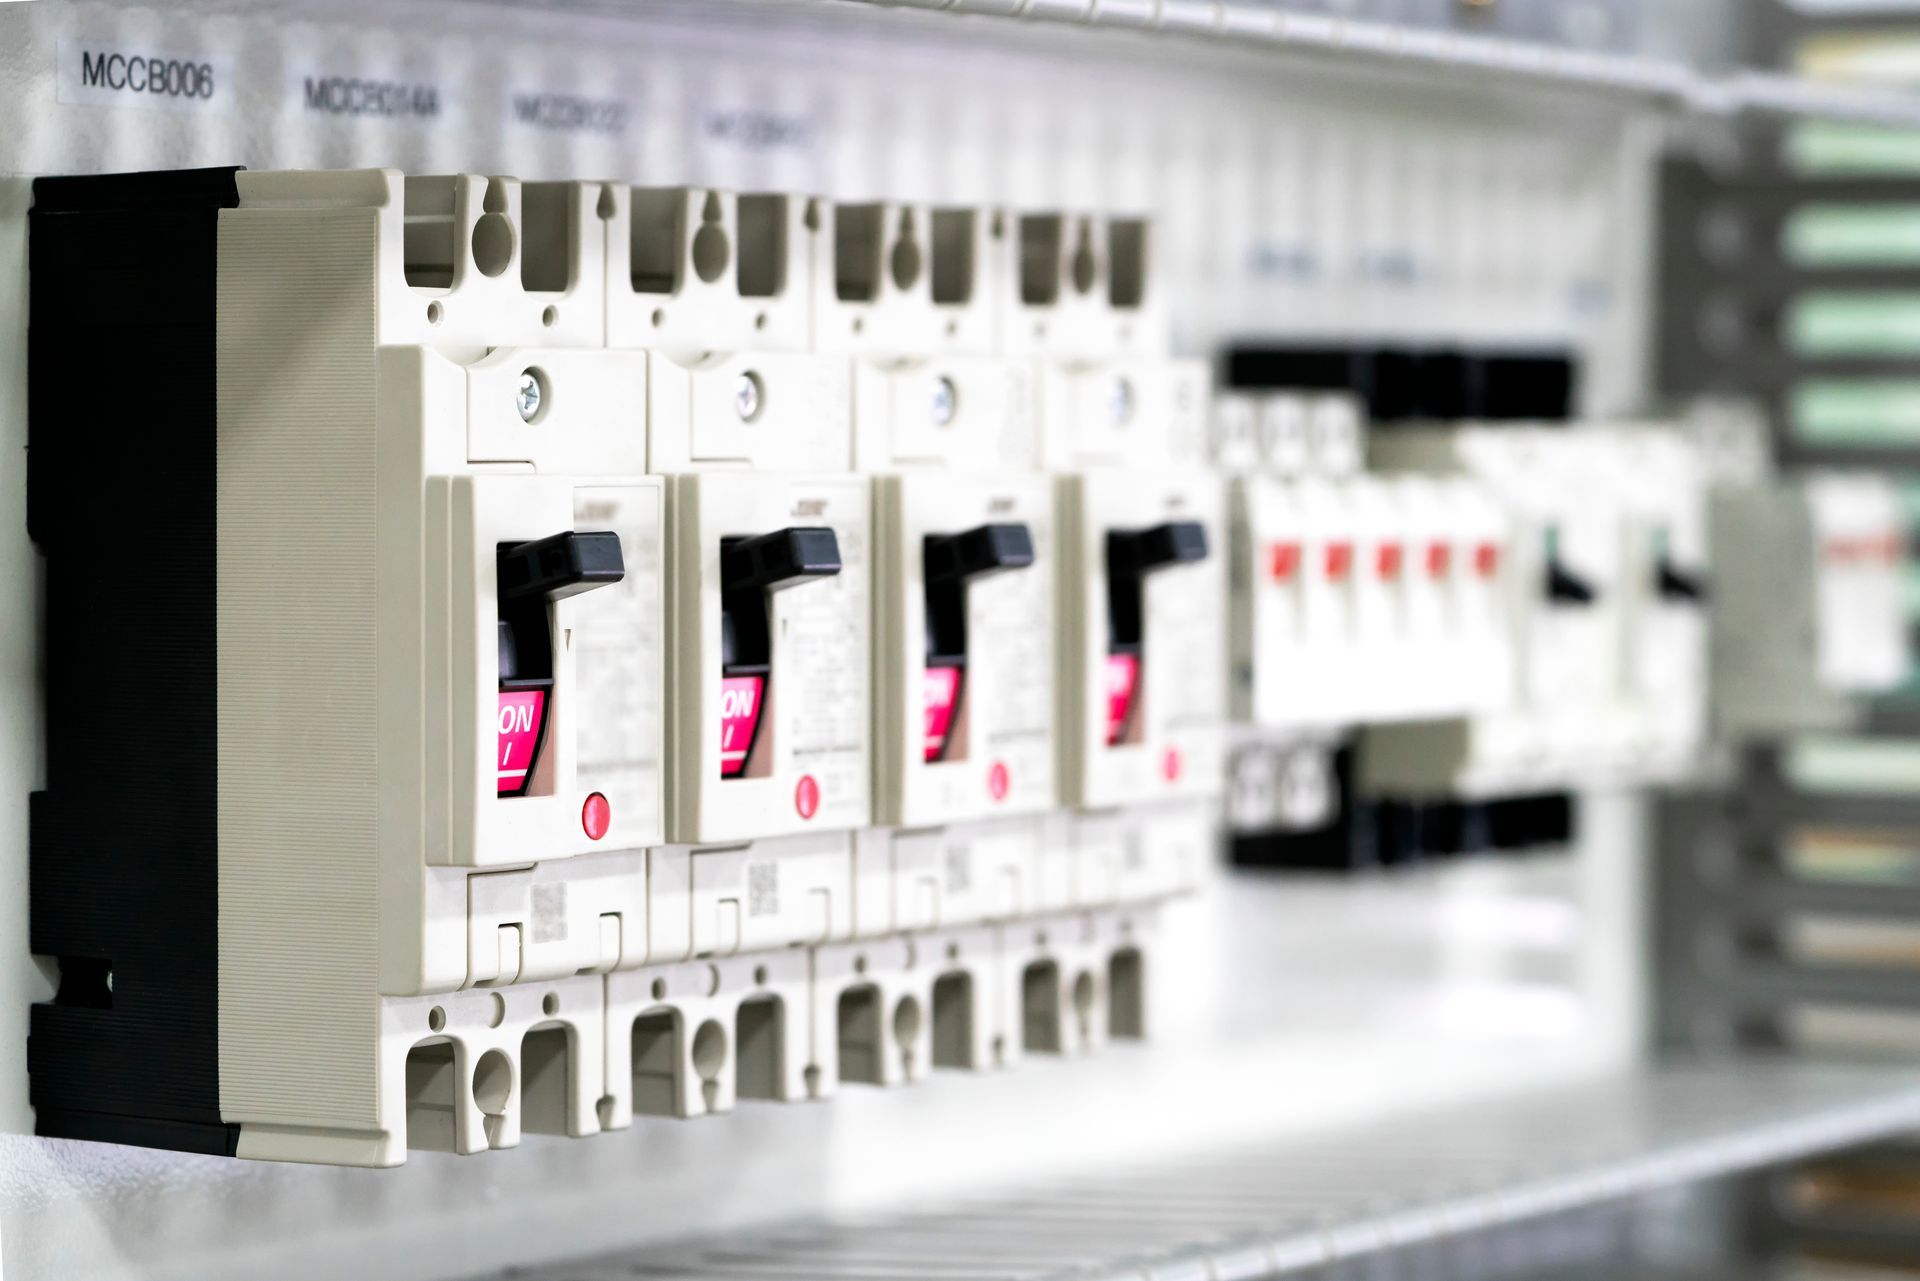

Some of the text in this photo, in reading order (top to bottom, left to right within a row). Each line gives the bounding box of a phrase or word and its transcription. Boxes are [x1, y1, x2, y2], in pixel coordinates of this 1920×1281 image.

[82, 50, 214, 100] MCCB006
[498, 704, 535, 735] ON
[721, 689, 755, 719] ON
